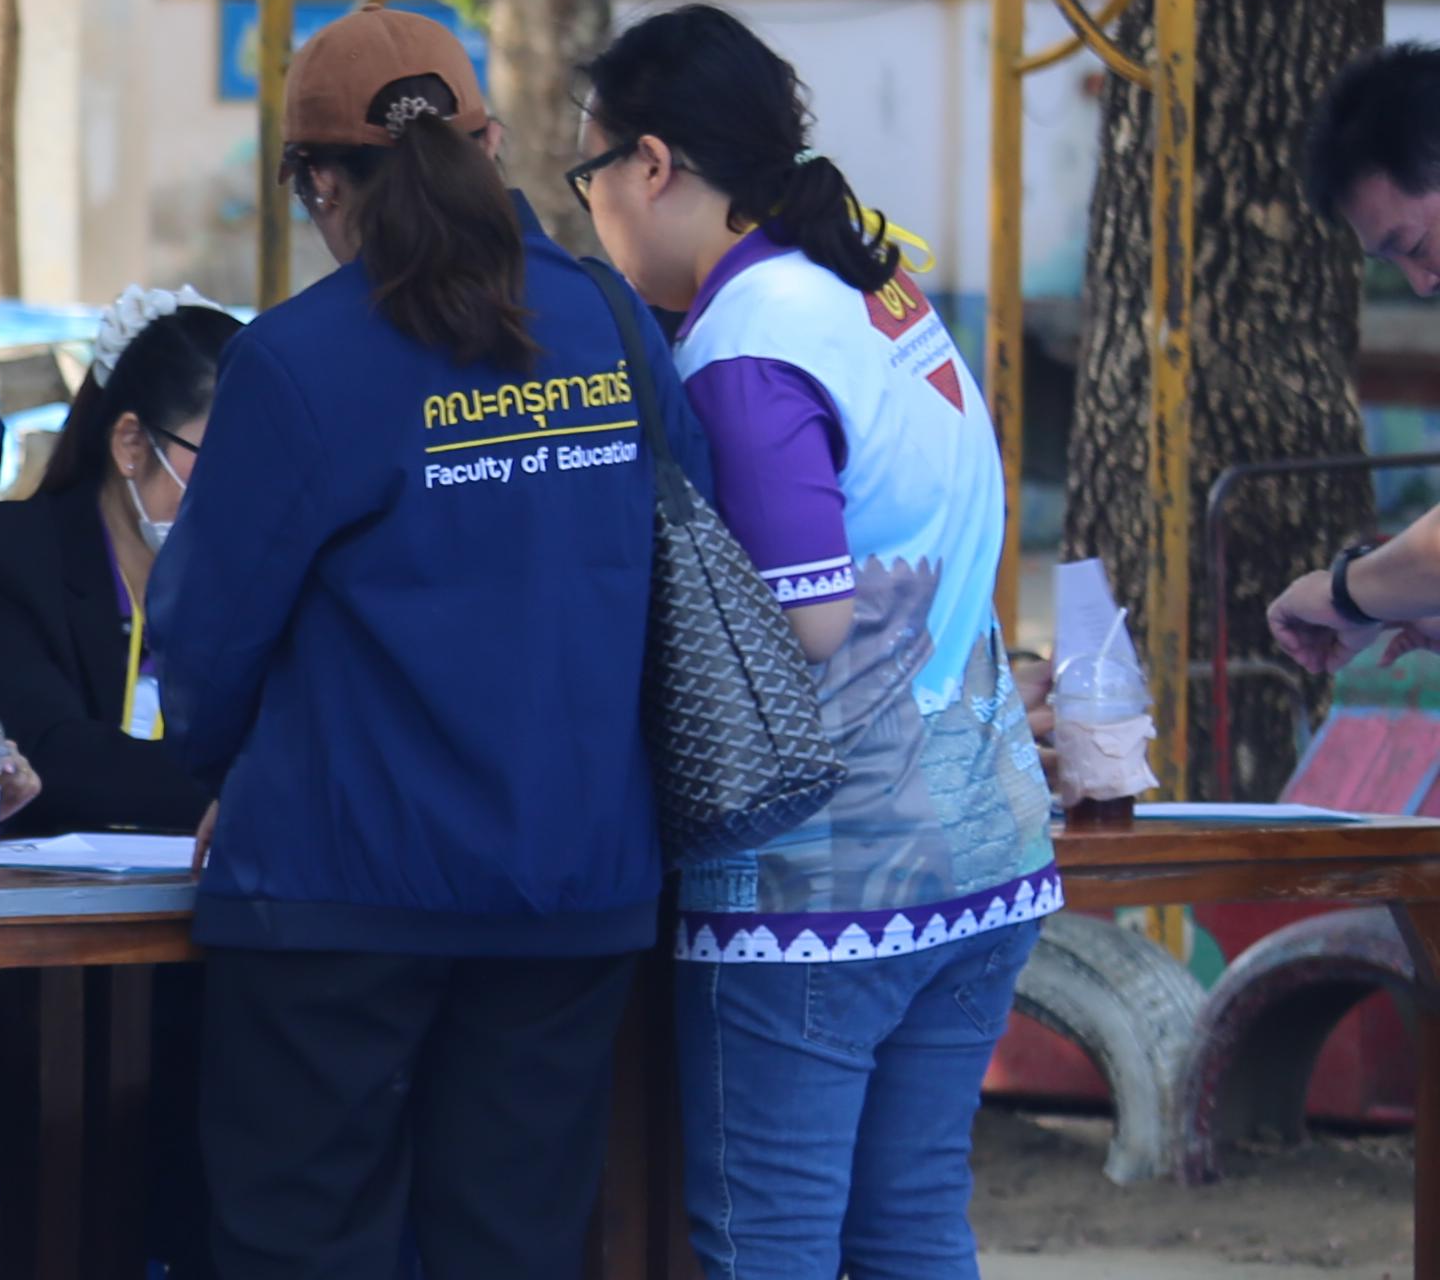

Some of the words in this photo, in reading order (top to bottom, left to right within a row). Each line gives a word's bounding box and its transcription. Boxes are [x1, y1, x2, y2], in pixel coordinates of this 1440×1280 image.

[423, 359, 633, 429] คณะครุศาสตร์
[424, 456, 513, 489] Faculty
[521, 446, 549, 475] of
[556, 440, 638, 471] Education
